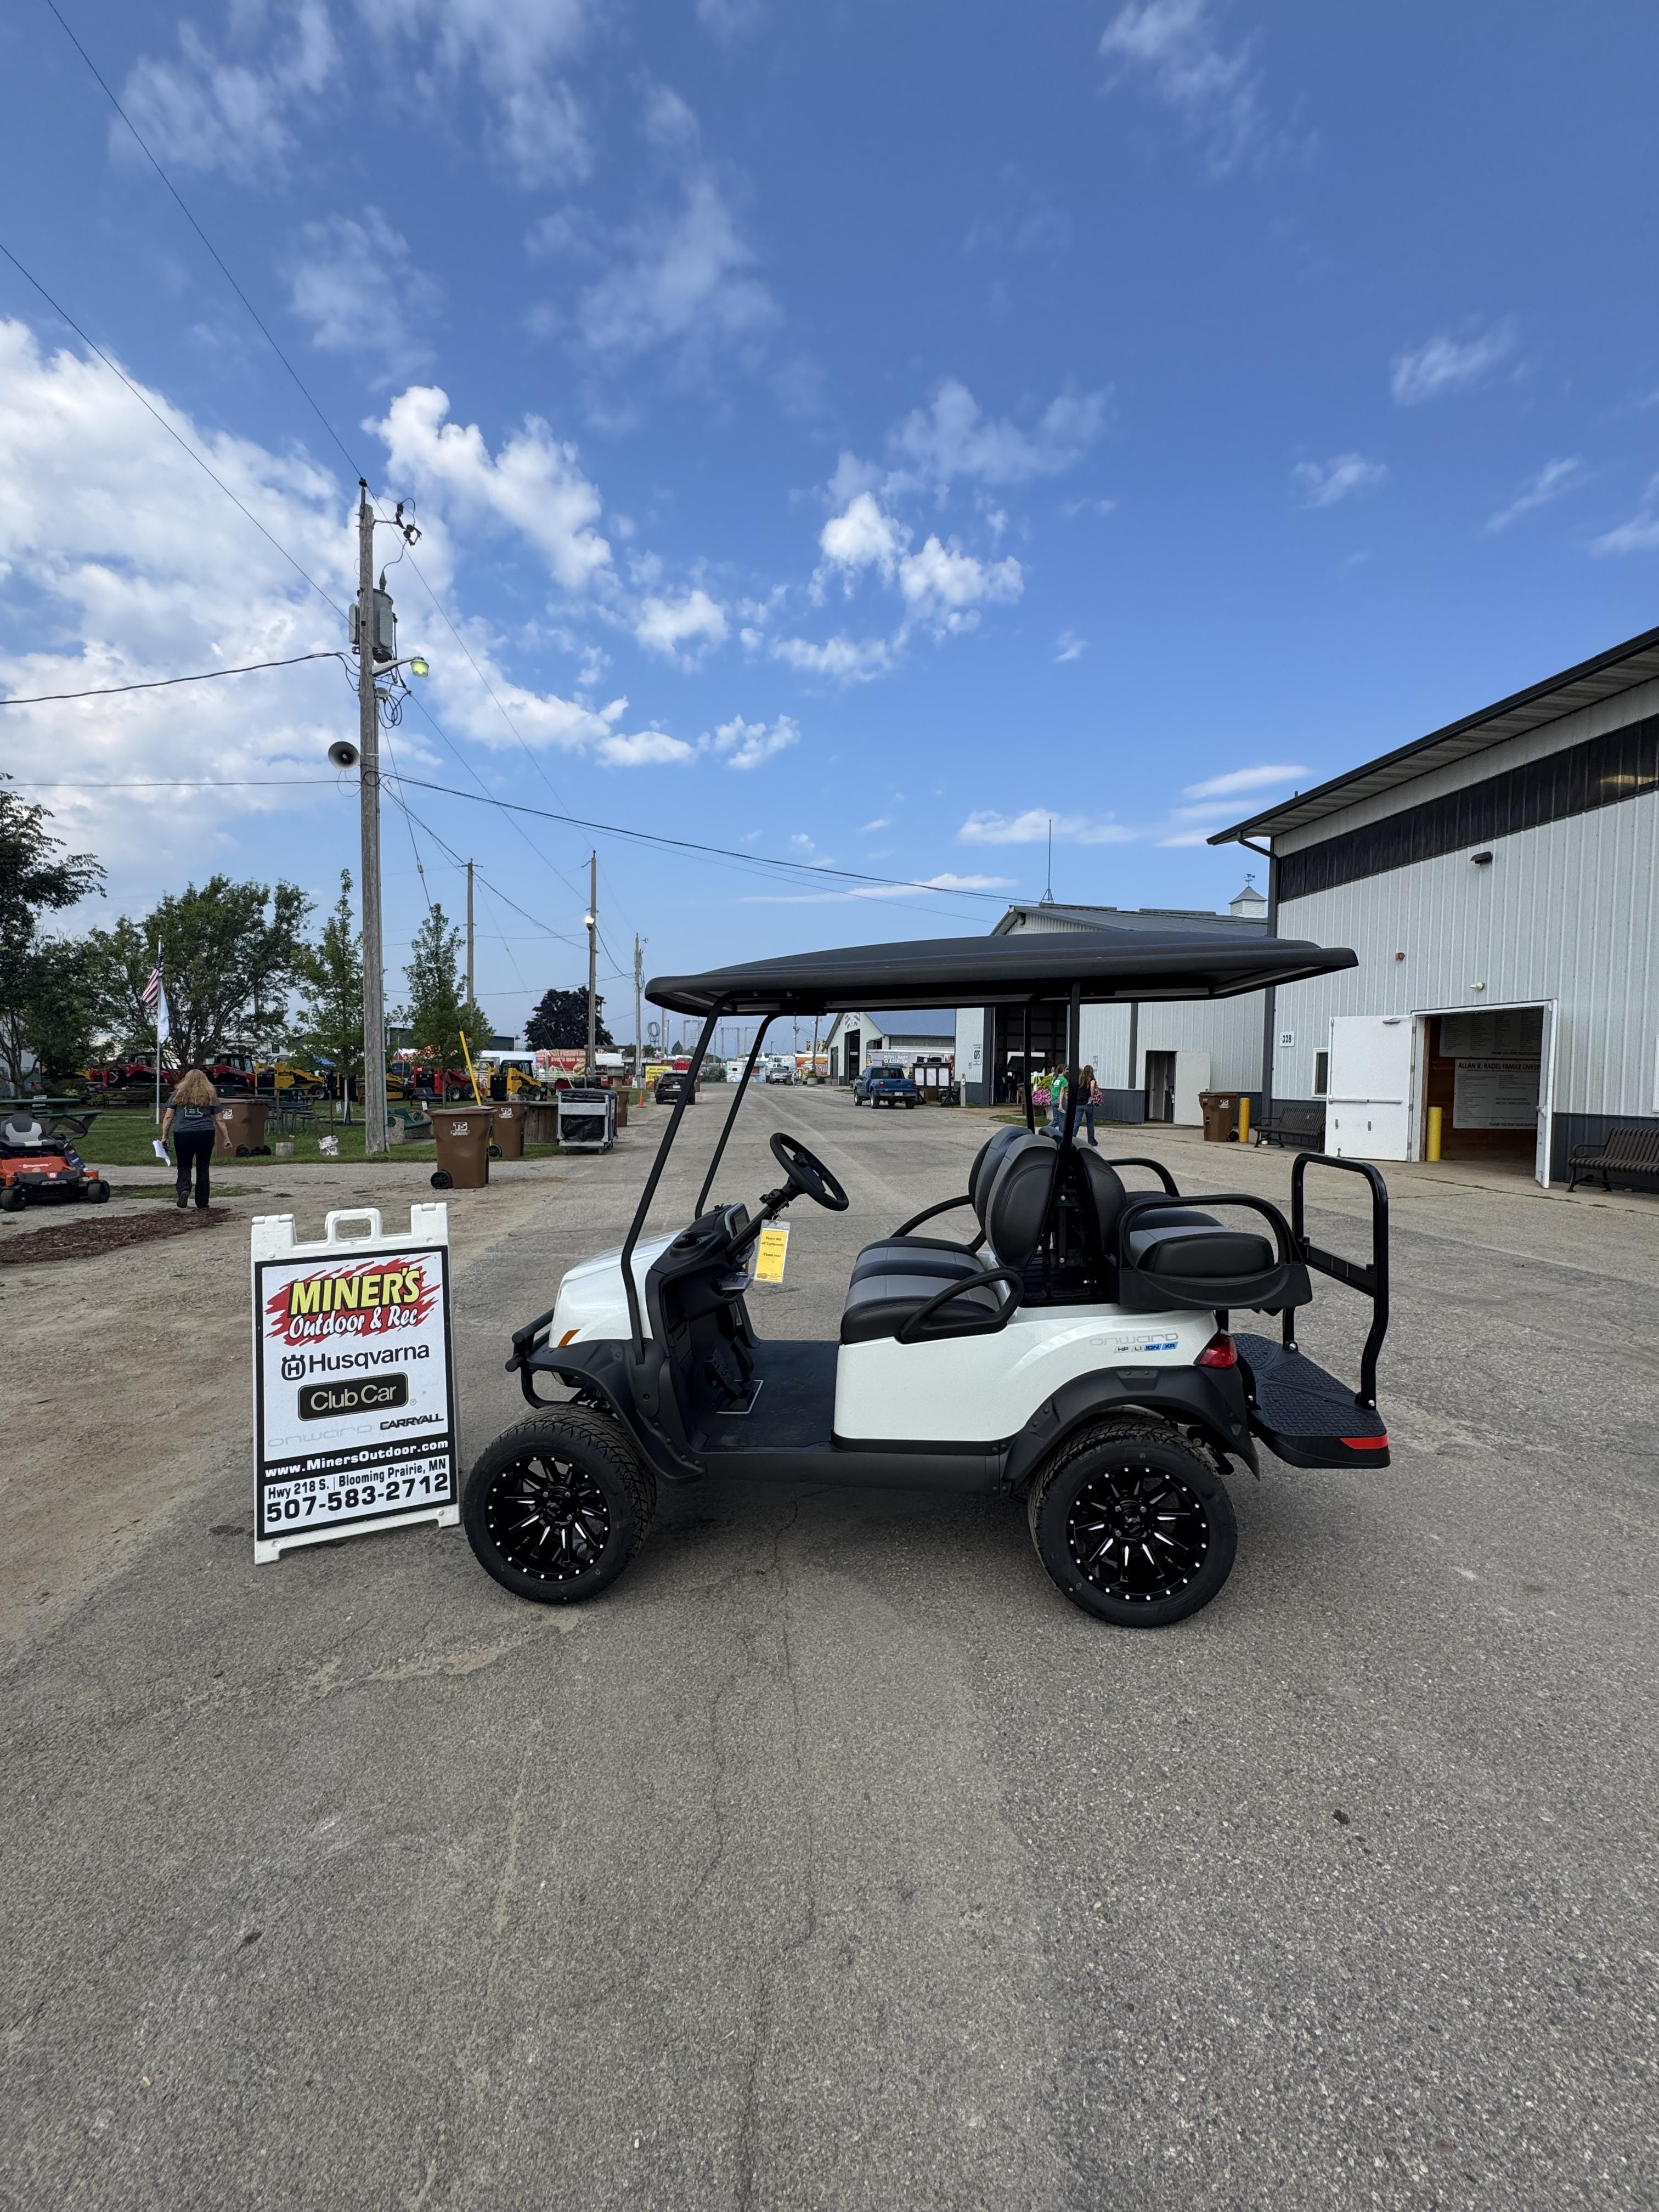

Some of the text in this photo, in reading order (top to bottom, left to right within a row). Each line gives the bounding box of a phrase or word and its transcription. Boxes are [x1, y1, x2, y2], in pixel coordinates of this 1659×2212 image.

[1282, 1034, 1292, 1043] 328
[289, 1267, 421, 1316] MINER'S
[289, 1305, 418, 1339] Outdoor & Rec
[309, 1344, 430, 1373] Husqvarna
[310, 1384, 397, 1411] Club Car
[380, 1413, 445, 1431] CARRYALL
[264, 1440, 448, 1477] www.MinersOutdoor.com
[268, 1457, 446, 1499] Hwy 218 S. Blooming Prairie, MN
[267, 1472, 448, 1522] 507-583-2712
